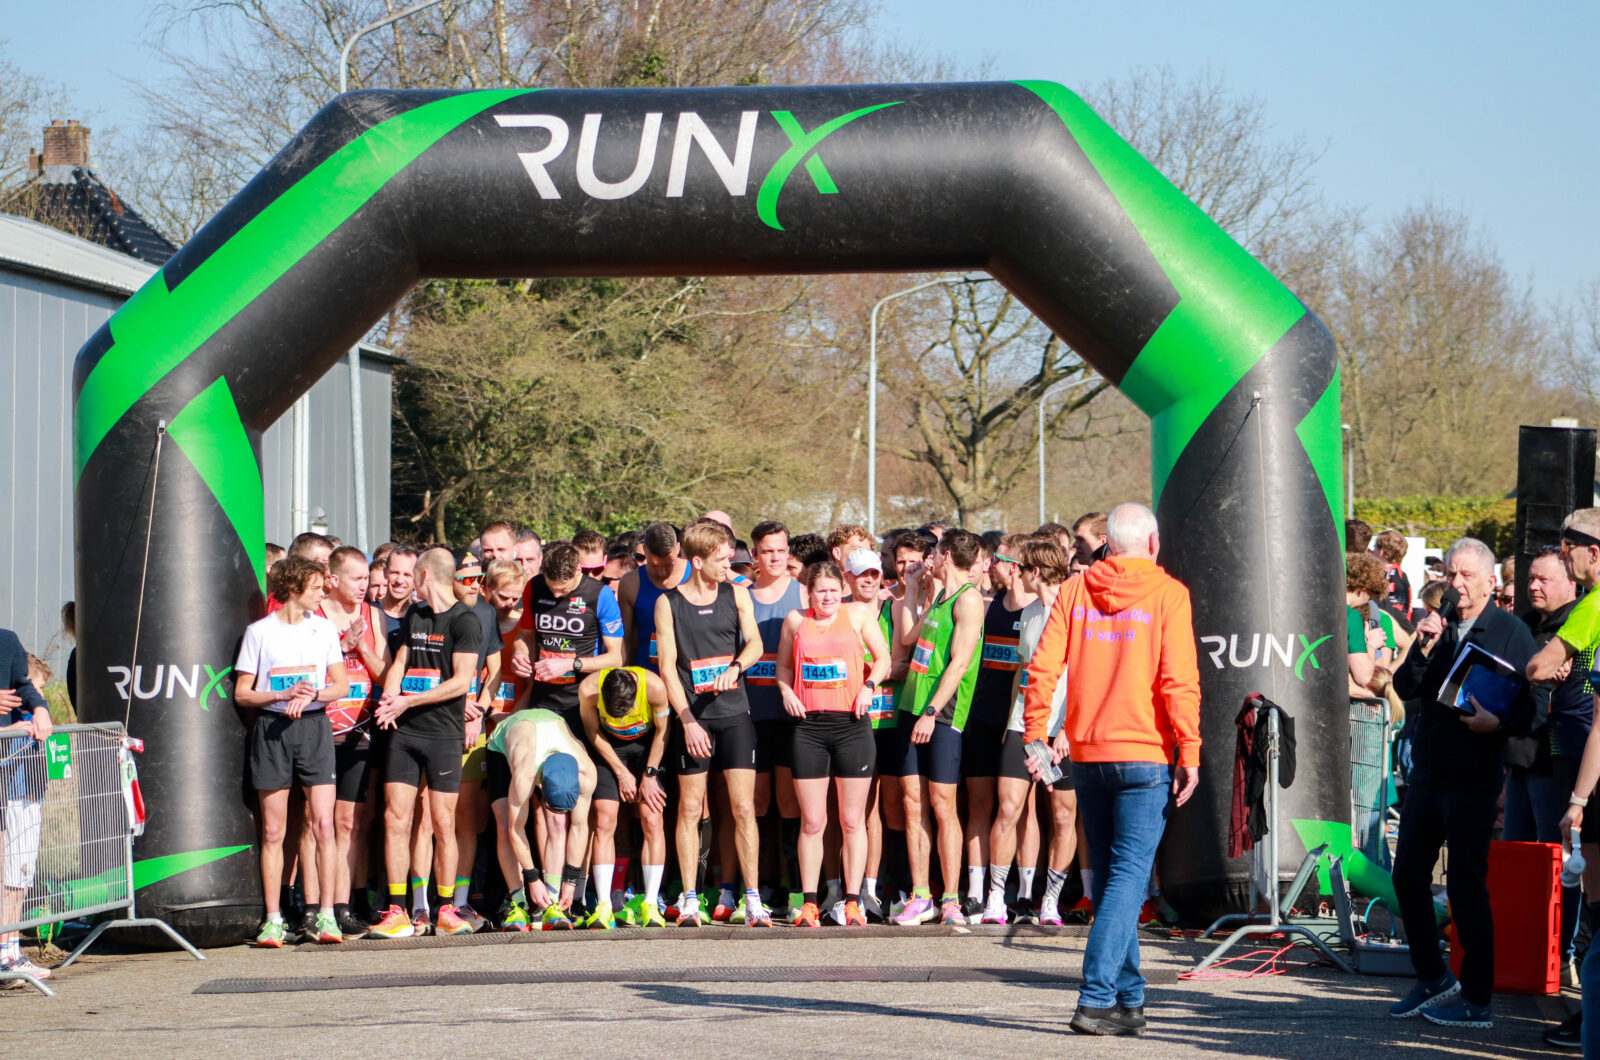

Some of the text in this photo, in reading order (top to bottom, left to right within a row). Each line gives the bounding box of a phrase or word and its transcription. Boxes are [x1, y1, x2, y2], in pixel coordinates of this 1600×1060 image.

[493, 100, 906, 231] RUNX
[539, 614, 585, 633] BDO
[1125, 629, 1135, 642] H
[986, 646, 1011, 660] 1299
[1200, 633, 1334, 681] RUNX
[804, 667, 835, 679] 1441
[106, 664, 236, 711] RUNX
[405, 678, 425, 692] 333
